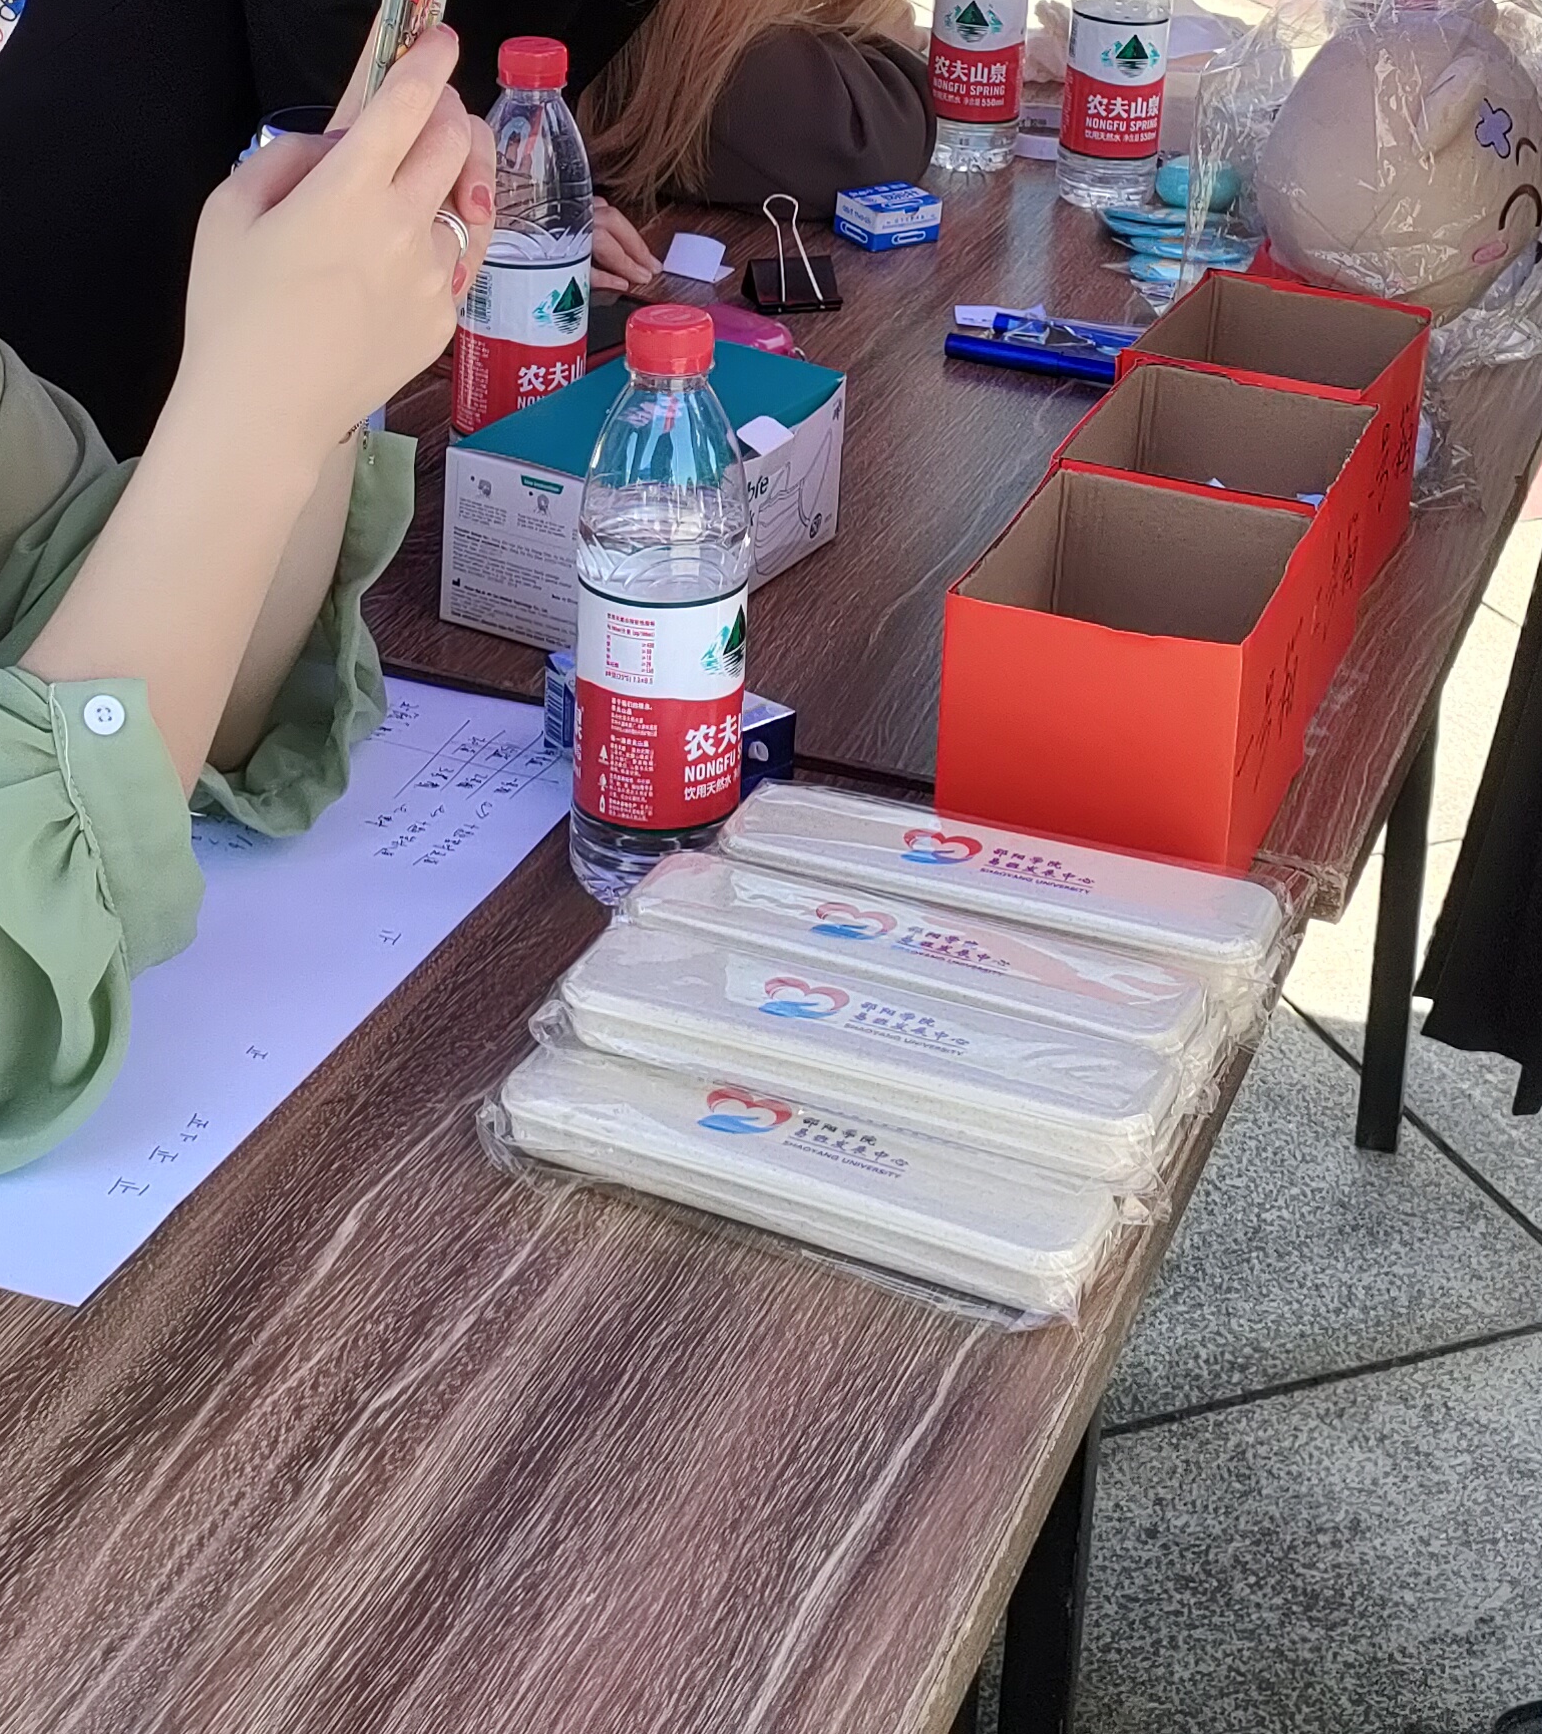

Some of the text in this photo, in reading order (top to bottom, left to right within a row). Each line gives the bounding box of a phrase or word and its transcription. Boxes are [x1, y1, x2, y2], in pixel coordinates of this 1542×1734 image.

[933, 55, 1008, 84] 农夫山泉
[932, 76, 1006, 97] NONGFU SPRING
[1086, 92, 1161, 120] 农夫山泉
[1085, 116, 1158, 133] NONGFU SPRING
[684, 754, 736, 784] NONGFU
[683, 776, 732, 802] 饮用天然水
[992, 847, 1063, 871] 邵阳学院
[979, 867, 1091, 895] SHAOYANG UNIVERSITY
[860, 1001, 936, 1028] 邵阳学院
[843, 1022, 965, 1057] SHAOYANG UNIVERSITY
[802, 1116, 878, 1147] 邵阳学院
[781, 1139, 902, 1179] SHAOYANG UNIVERSITY
[793, 1127, 910, 1167] 易班发展中心
